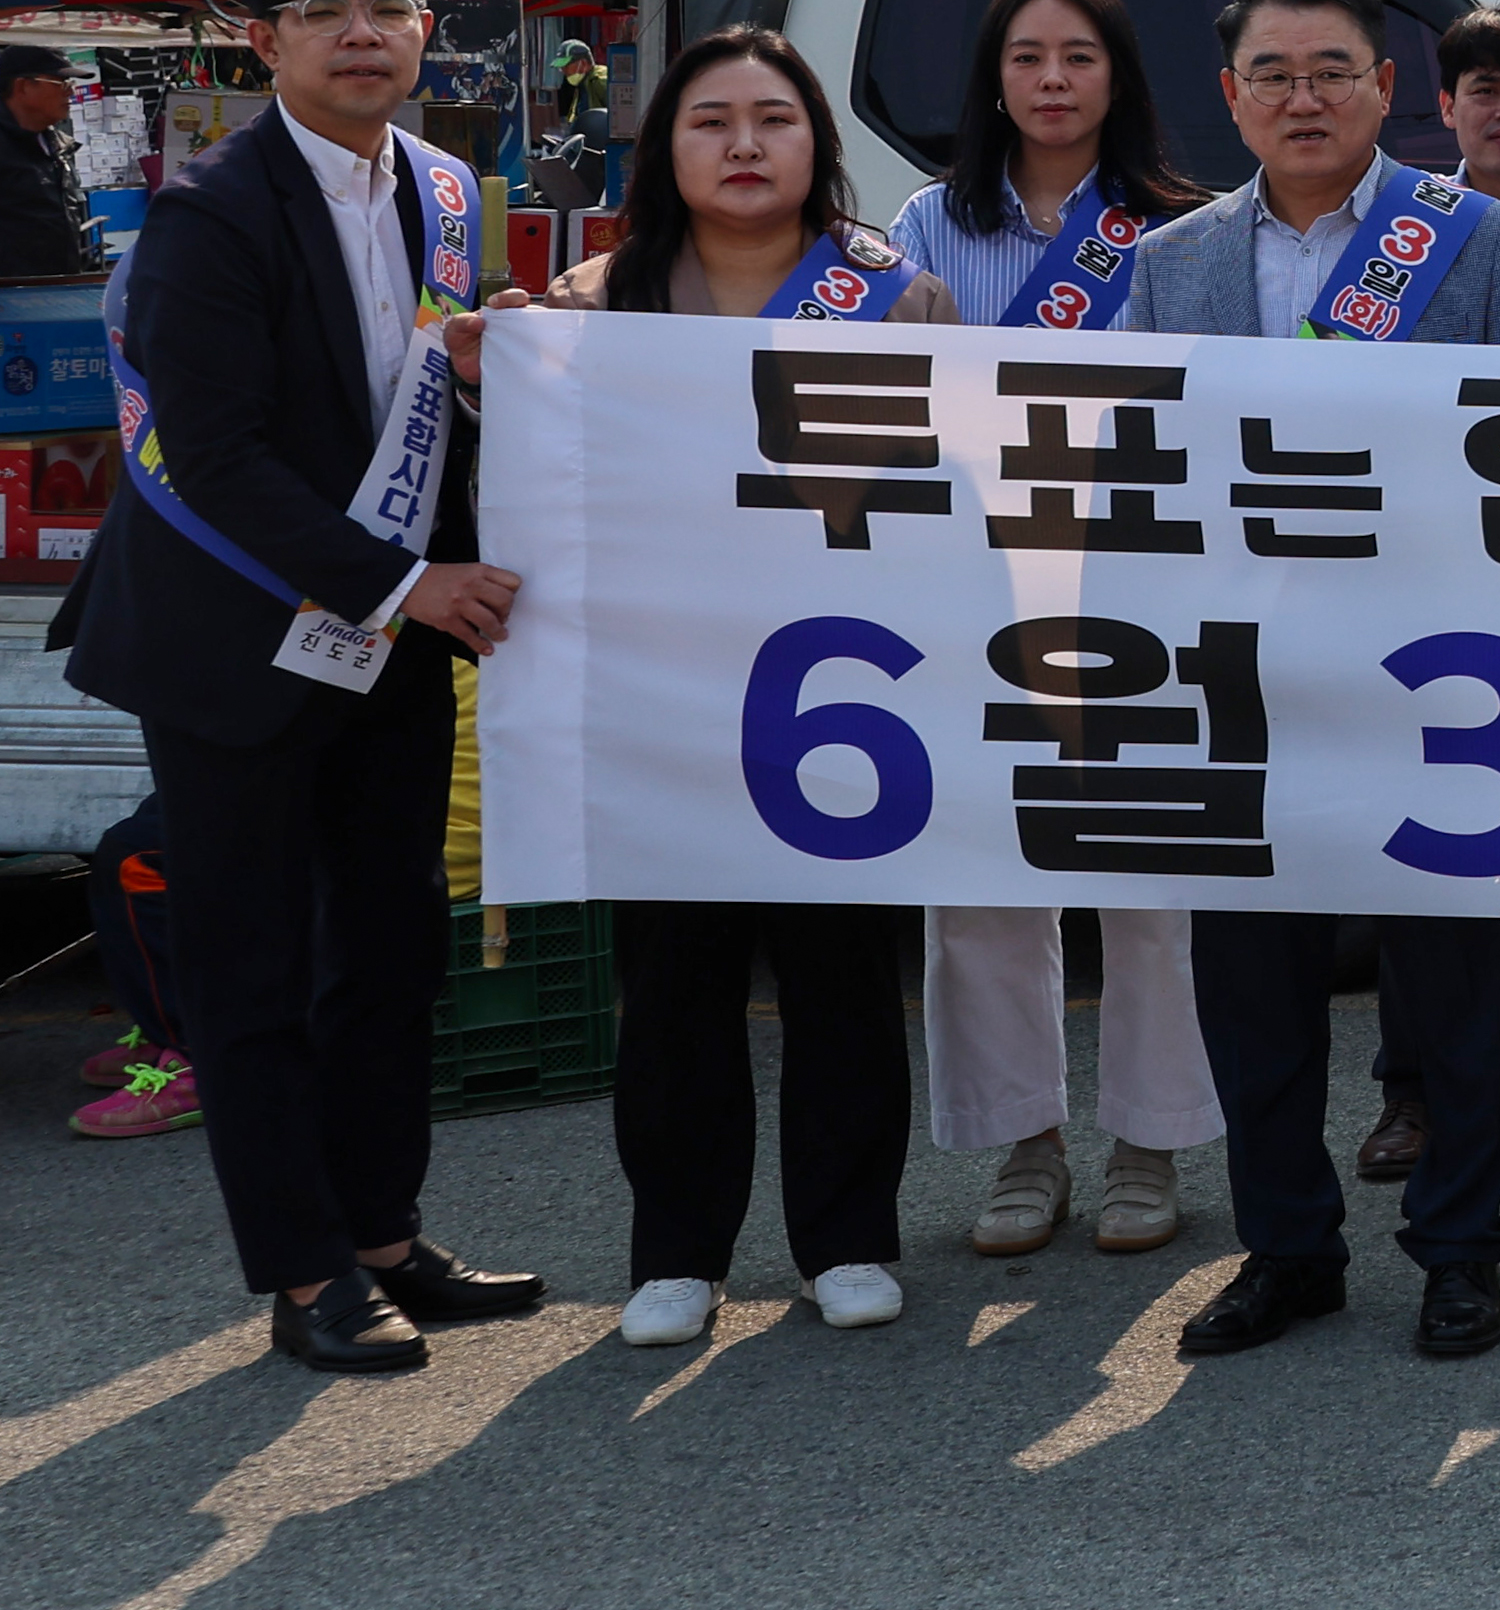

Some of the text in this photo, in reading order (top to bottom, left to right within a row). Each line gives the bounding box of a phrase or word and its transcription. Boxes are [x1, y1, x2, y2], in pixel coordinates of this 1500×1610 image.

[1073, 203, 1147, 283] 6월
[49, 358, 116, 383] 찰토마
[736, 349, 1384, 559] 투표는
[740, 615, 1275, 878] 6월
